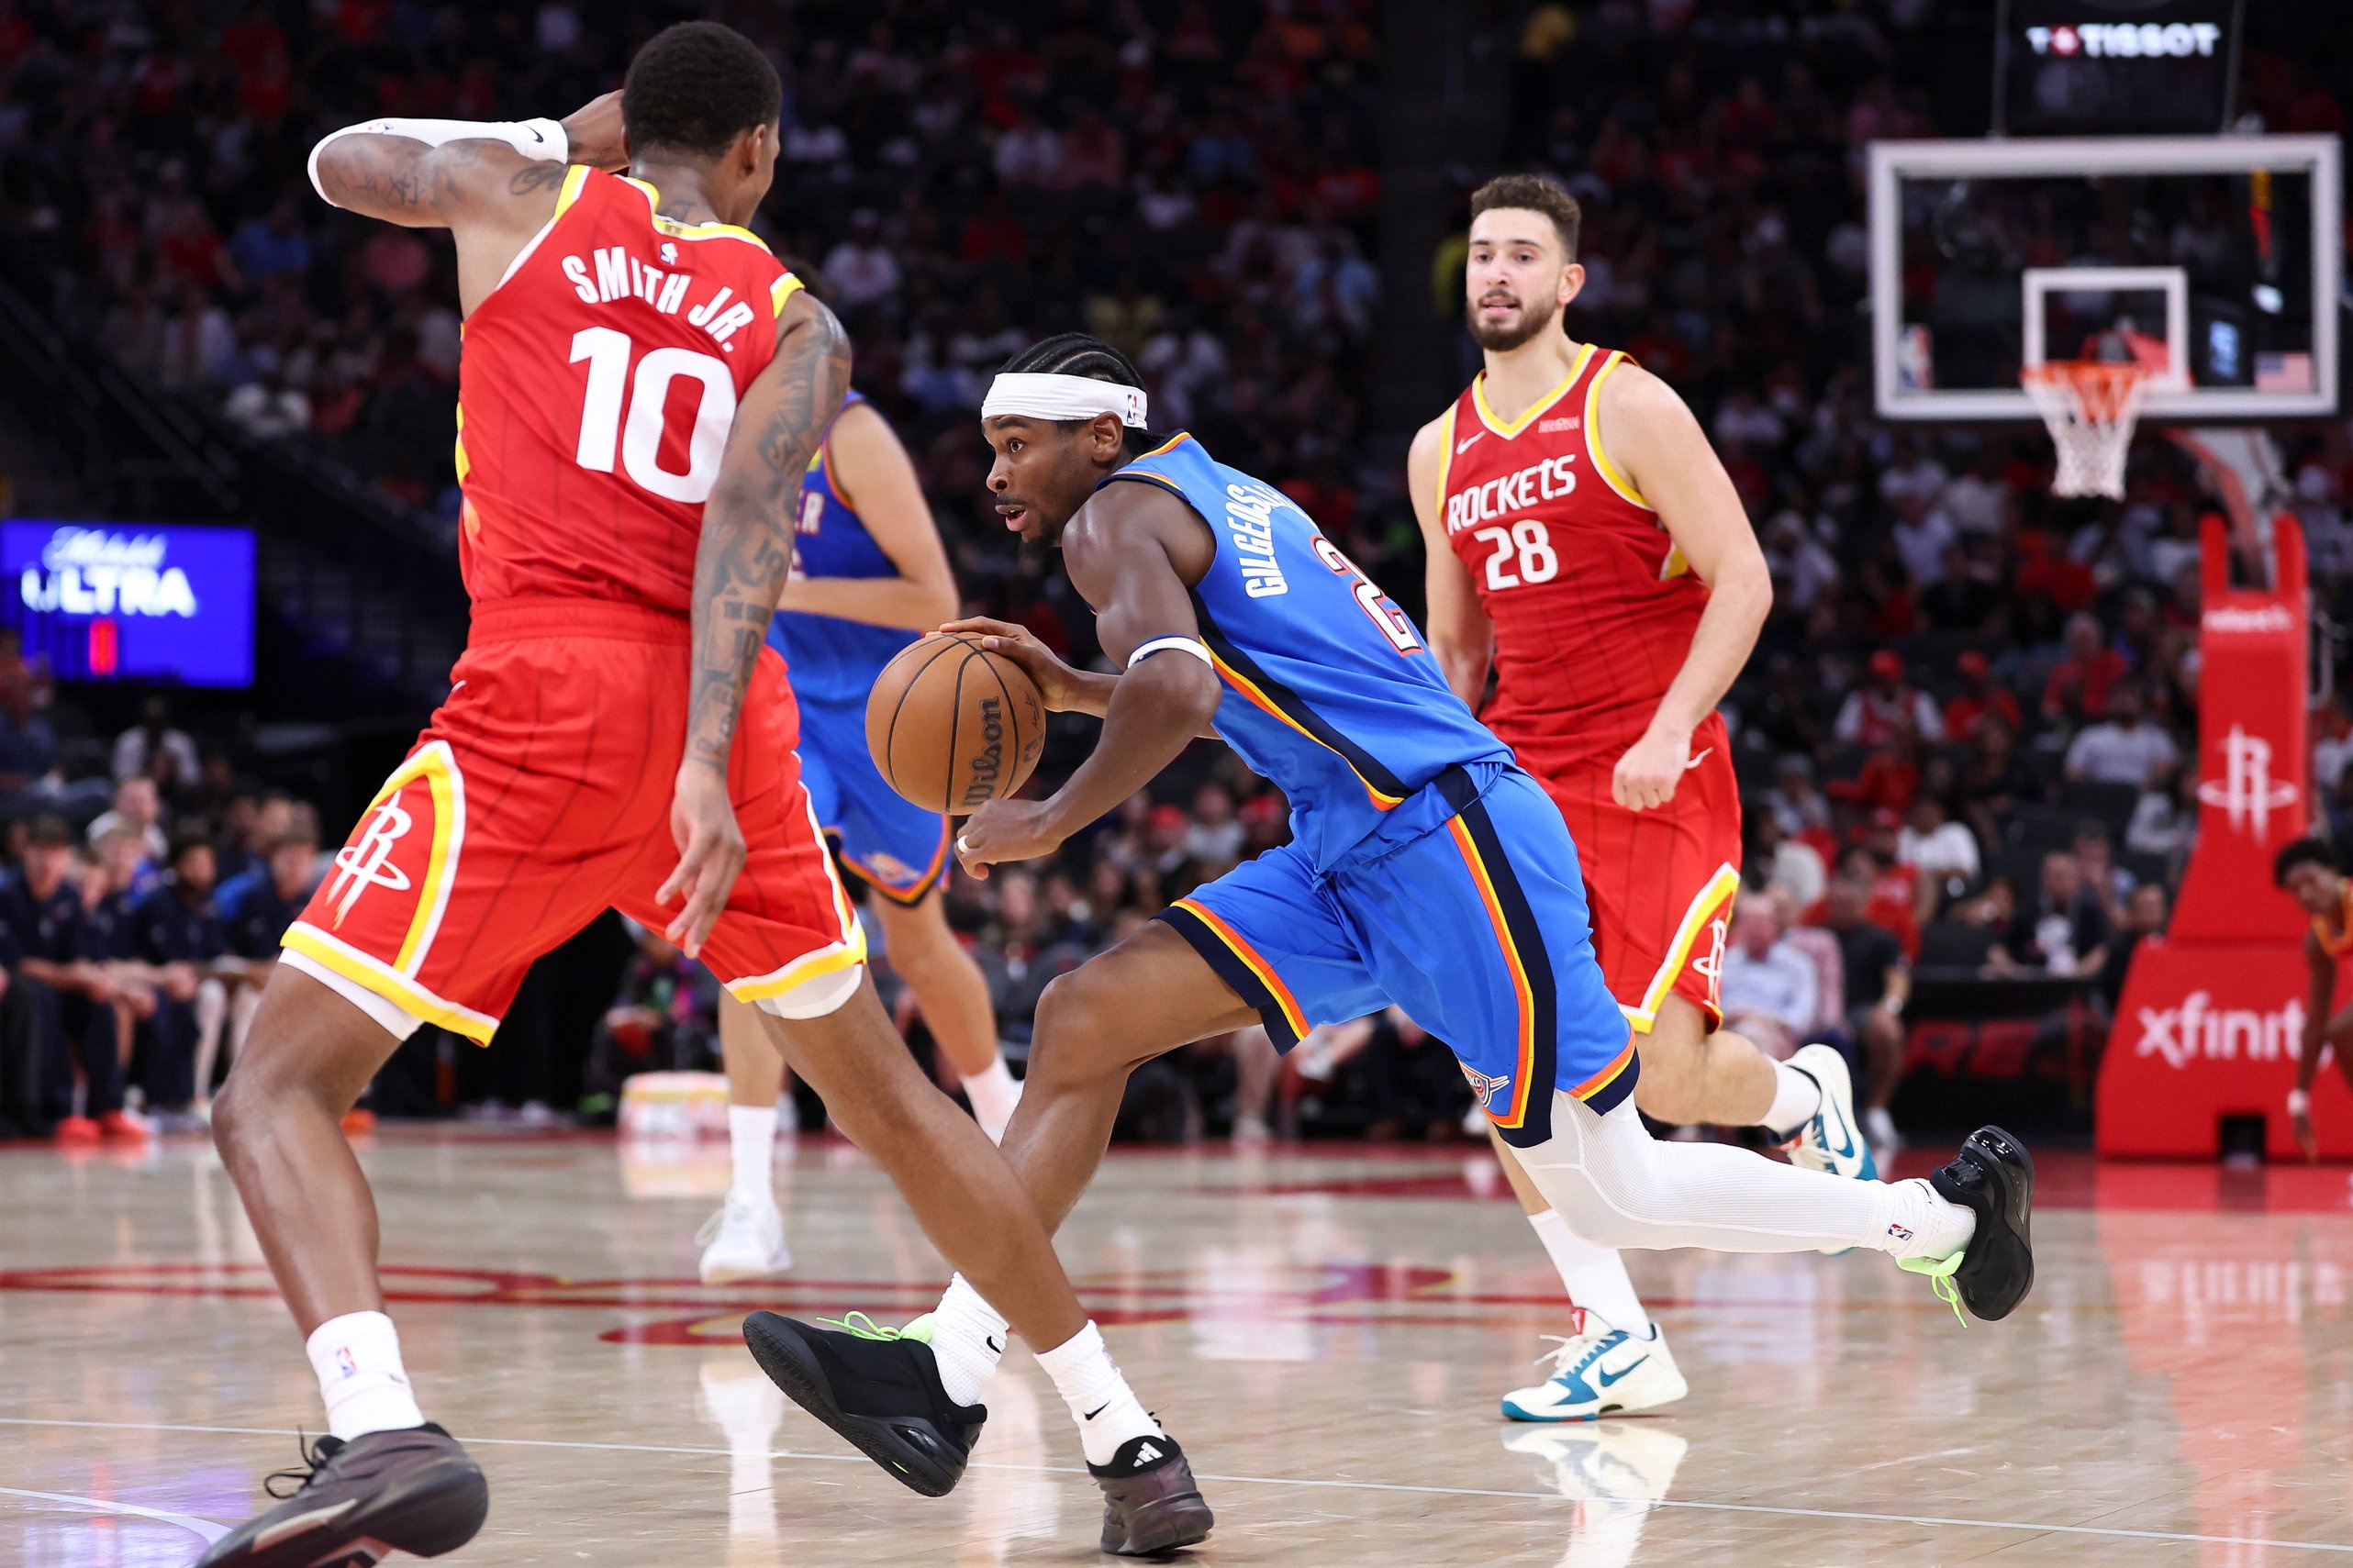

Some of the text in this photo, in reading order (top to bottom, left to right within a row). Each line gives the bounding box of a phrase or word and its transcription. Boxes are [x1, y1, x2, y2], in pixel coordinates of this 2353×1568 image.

[561, 246, 755, 353] SMITH JR.
[568, 326, 737, 504] 10
[1447, 453, 1577, 537] ROCKETS
[21, 564, 197, 618] ULTRA
[1310, 534, 1424, 658] 2
[1473, 519, 1559, 592] 28
[961, 695, 1003, 807] Wilson
[2136, 989, 2335, 1072] xfinit
